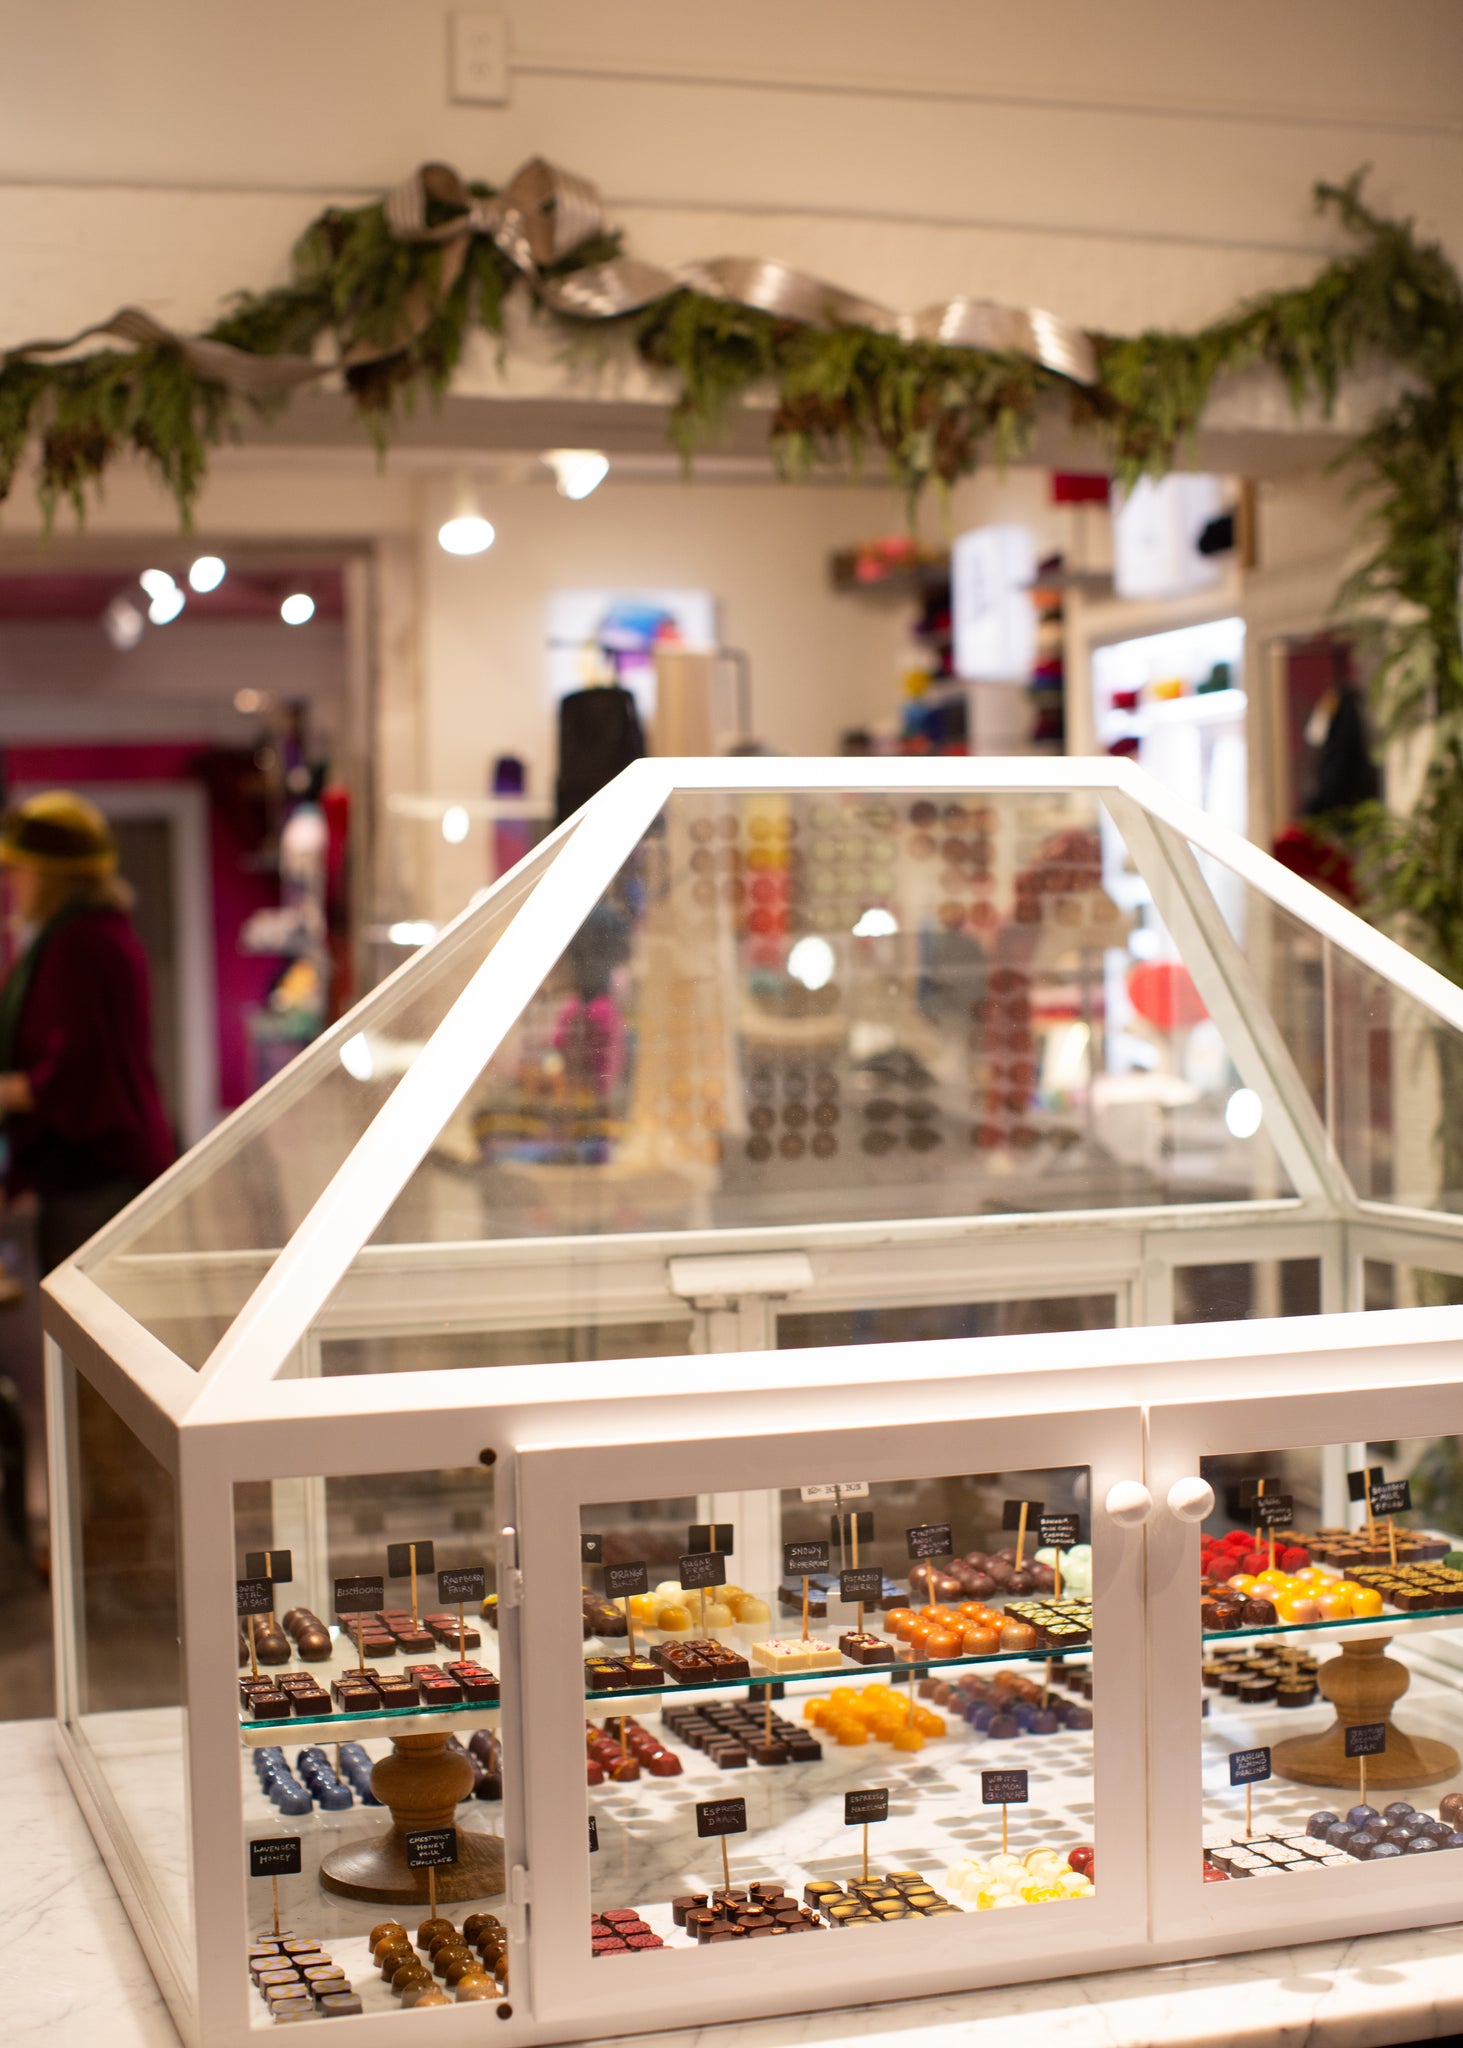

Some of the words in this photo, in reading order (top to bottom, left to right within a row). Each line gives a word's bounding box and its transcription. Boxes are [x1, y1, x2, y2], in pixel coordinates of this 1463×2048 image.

[791, 1546, 821, 1559] SNOWY
[610, 1567, 644, 1580] ORANGE
[448, 1584, 474, 1595] FAIRY
[988, 1783, 1022, 1792] LEMON
[416, 1841, 446, 1851] HONEY
